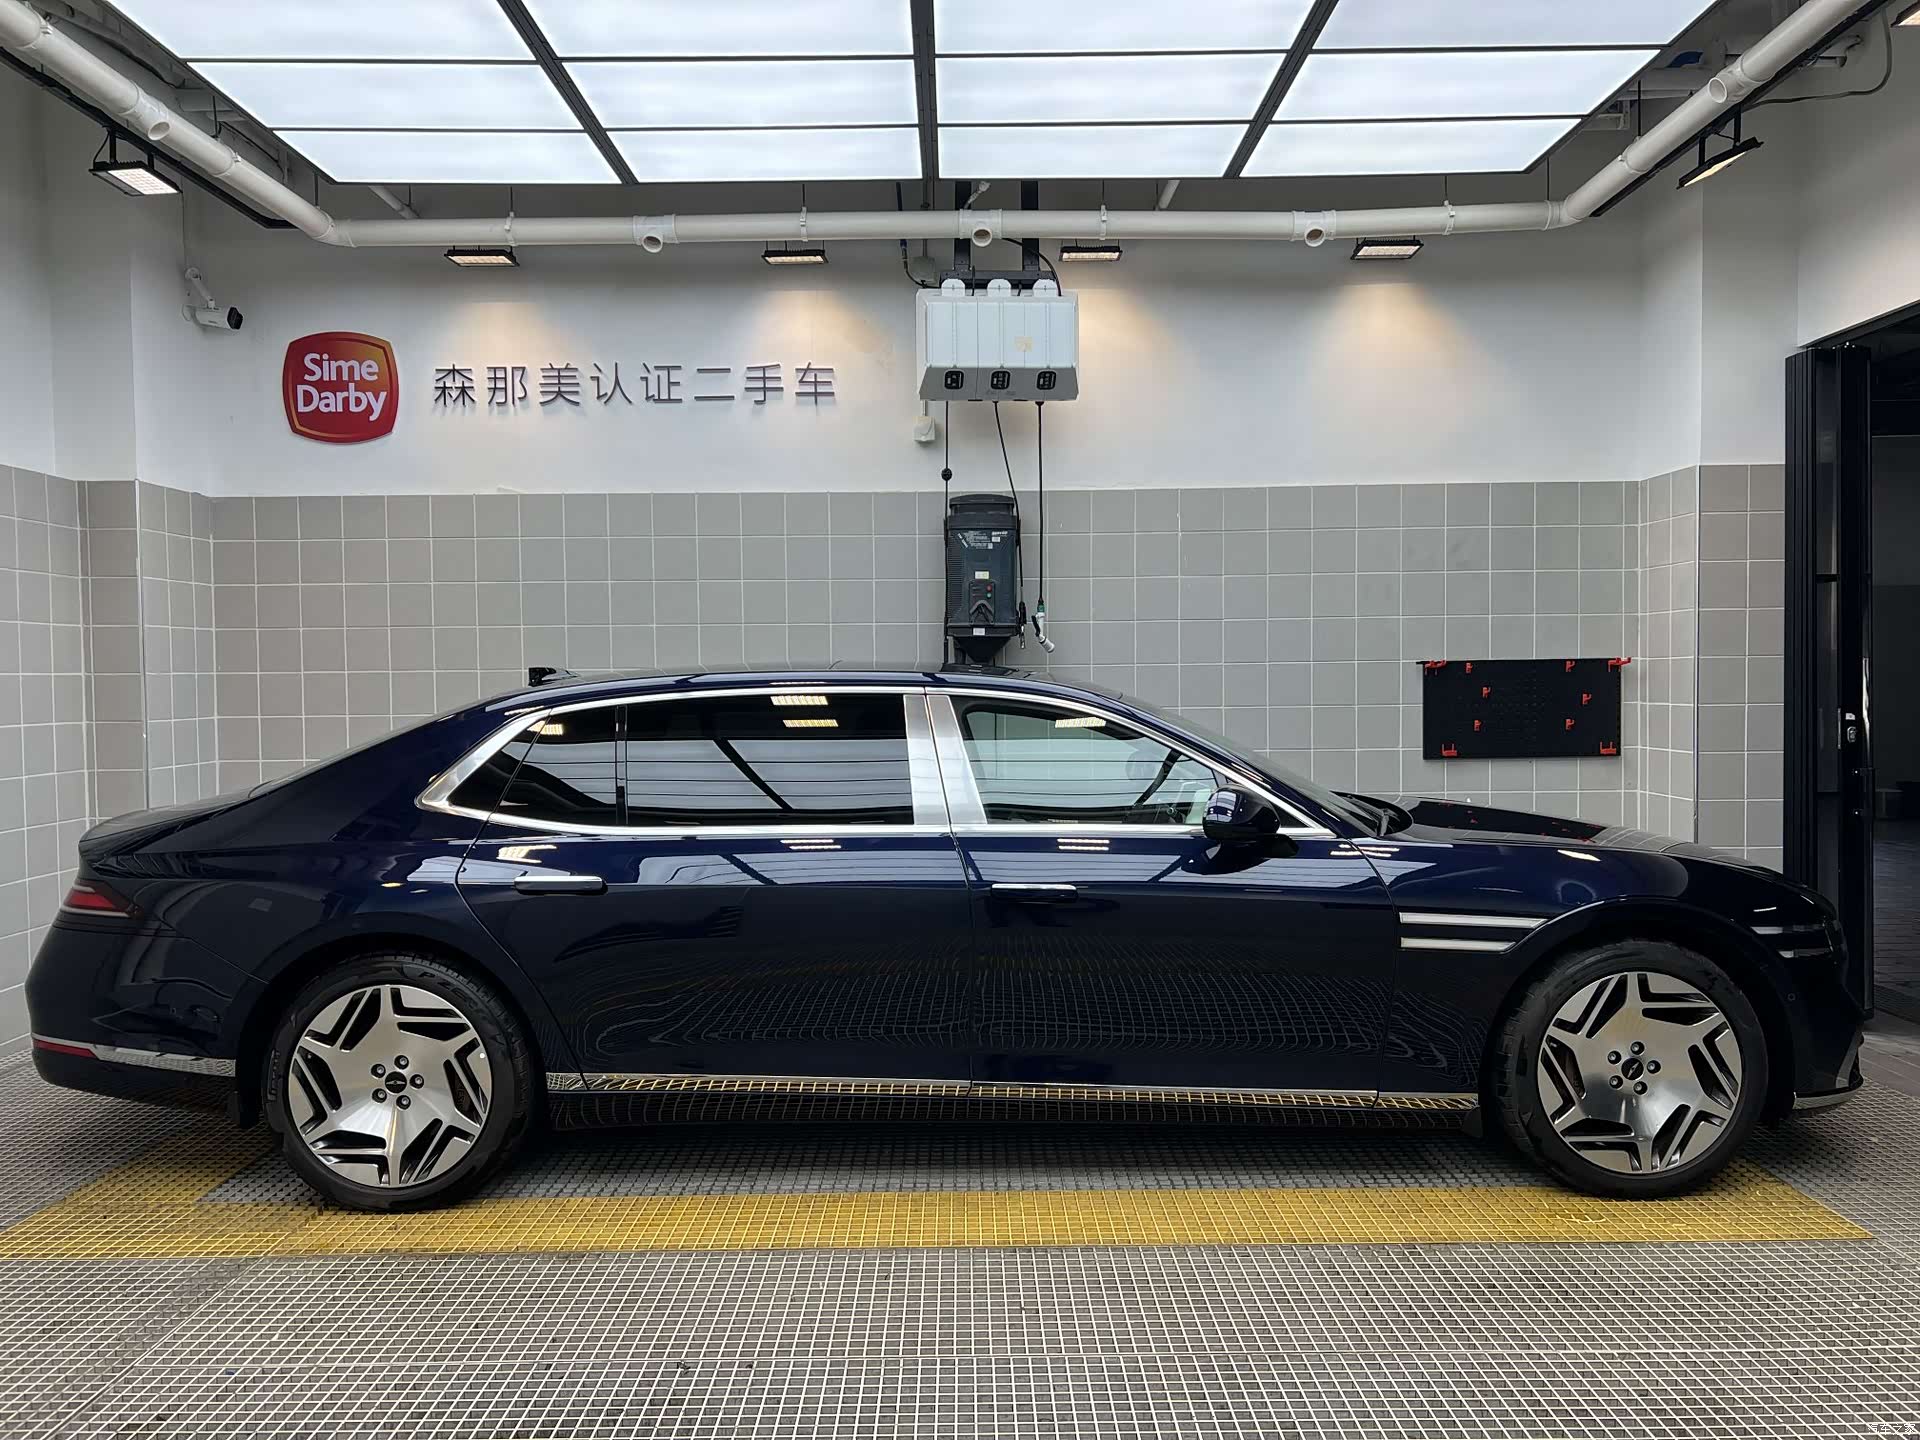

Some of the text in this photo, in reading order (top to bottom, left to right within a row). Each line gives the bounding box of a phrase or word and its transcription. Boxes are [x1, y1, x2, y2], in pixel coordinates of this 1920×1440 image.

[303, 352, 379, 382] Sime
[434, 362, 835, 408] 森那美认证二手车
[296, 382, 388, 422] Darby
